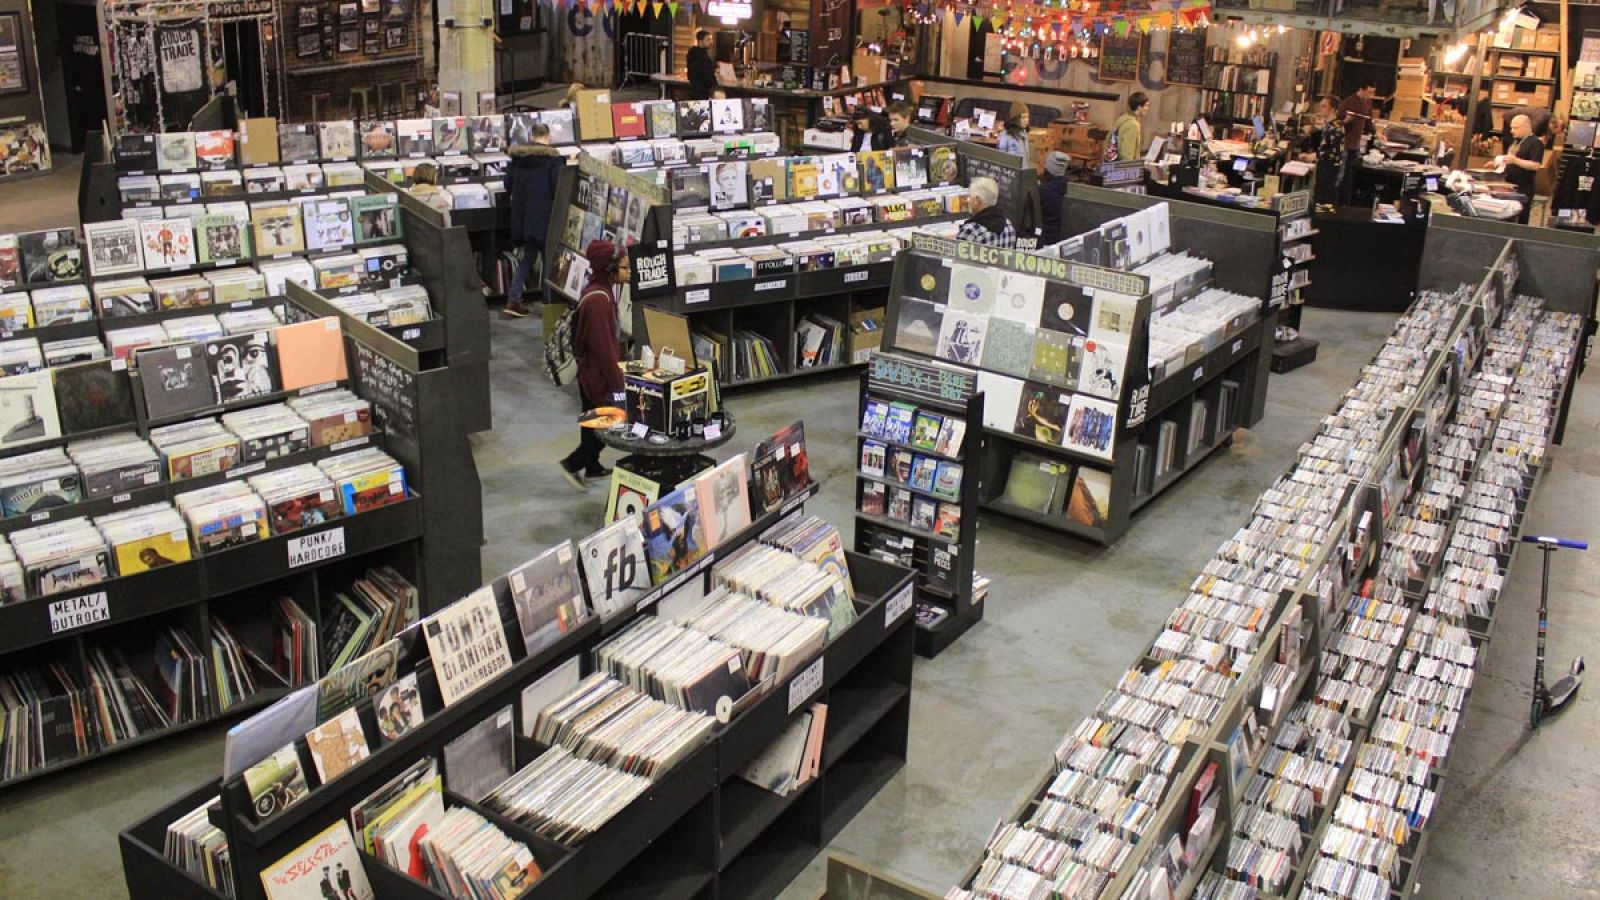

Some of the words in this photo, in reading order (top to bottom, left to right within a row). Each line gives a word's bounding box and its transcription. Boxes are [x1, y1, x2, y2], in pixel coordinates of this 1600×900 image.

[160, 28, 193, 48] ROUGH
[162, 43, 196, 61] TRADE
[636, 253, 667, 270] ROUGH
[958, 240, 1065, 278] ELECTRONIC
[638, 266, 668, 281] TRADE
[299, 532, 333, 549] PUNK/
[290, 542, 344, 566] HARDCORE
[603, 542, 637, 601] fb
[54, 594, 101, 615] METAL/
[51, 606, 109, 633] OUTROCK
